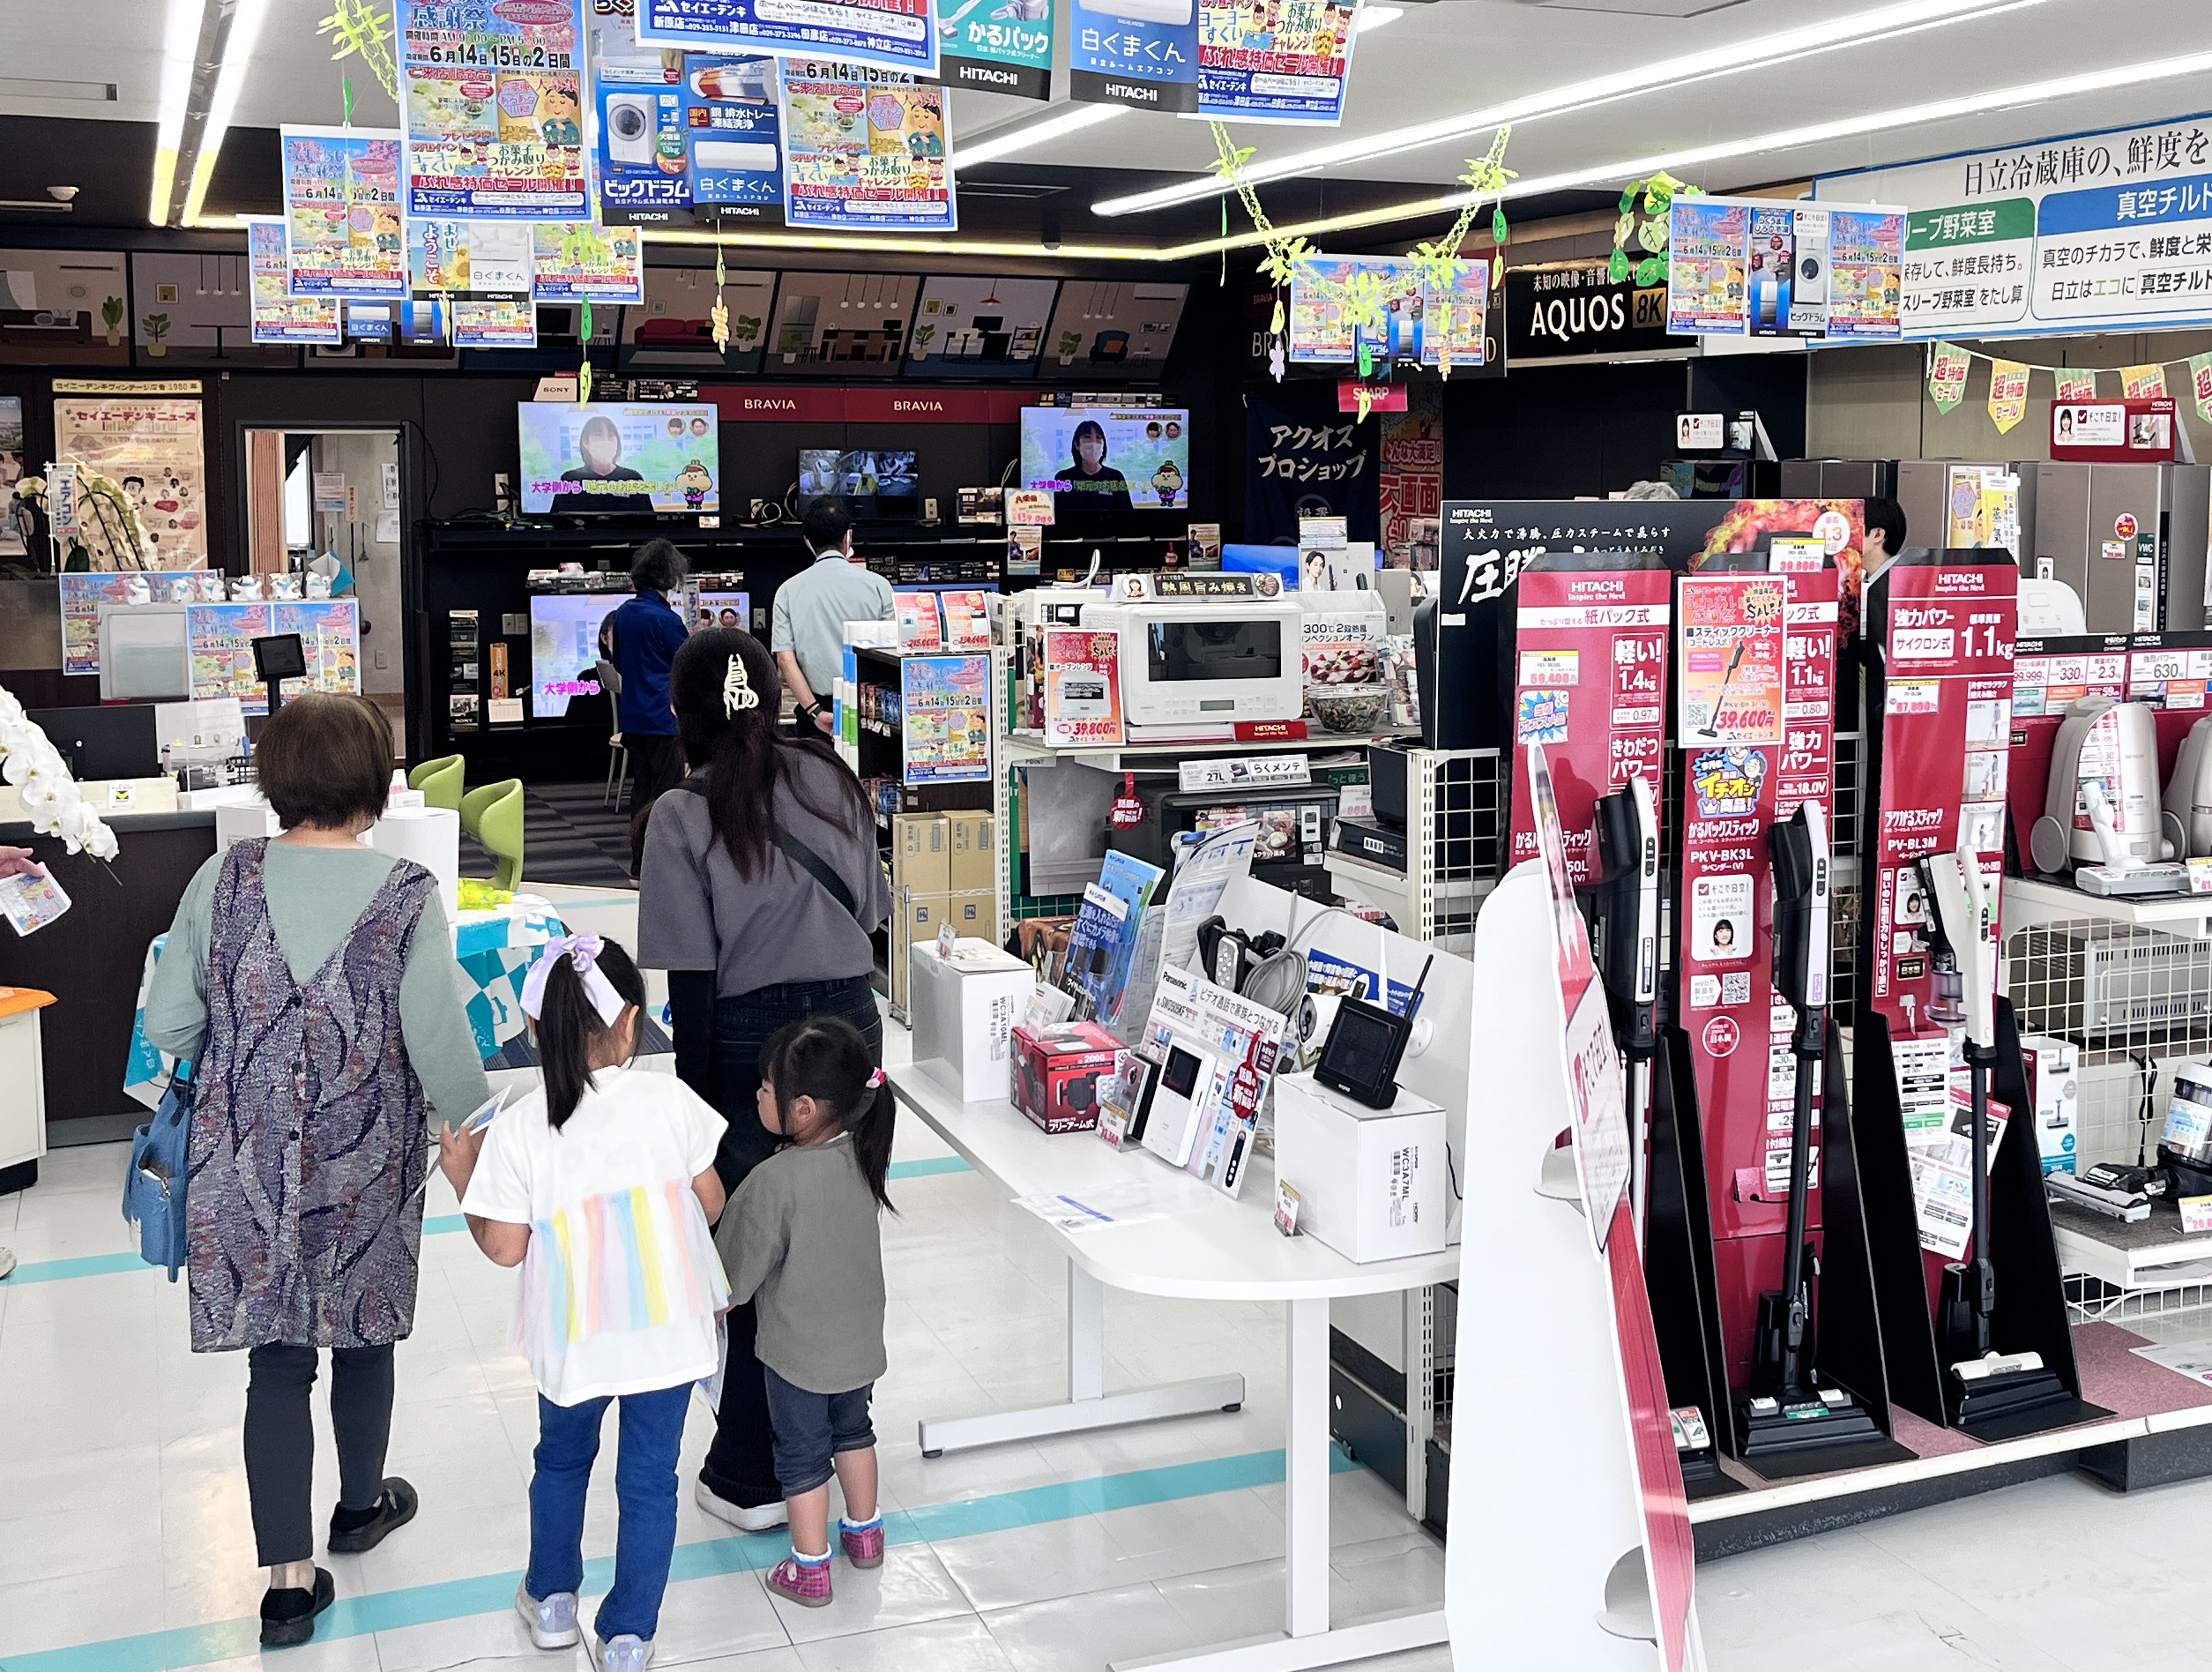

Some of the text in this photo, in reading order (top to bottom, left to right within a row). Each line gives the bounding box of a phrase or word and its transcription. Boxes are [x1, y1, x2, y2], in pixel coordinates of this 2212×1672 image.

[413, 6, 485, 31] 感謝祭
[681, 3, 746, 18] セイエーデンキ
[1288, 3, 1316, 18] お菓子
[1277, 18, 1322, 34] つかみ取り
[967, 21, 1049, 52] かるパック
[1206, 26, 1243, 43] すくい
[1081, 28, 1186, 63] 白くまくん
[959, 67, 1018, 86] HITACHI
[1106, 84, 1158, 101] HITACHI
[499, 146, 533, 155] お菓子
[488, 154, 545, 166] つかみ取り
[869, 156, 899, 166] お菓子
[1965, 129, 2209, 197] 日立冷蔵庫の、鮮度を
[859, 166, 911, 176] つかみ取り
[605, 179, 690, 198] ビッグドラム
[700, 177, 776, 193] 白くまくん
[720, 207, 759, 216] HITACHI
[423, 224, 439, 284] ようこそ
[473, 271, 525, 280] 白くまくん
[2052, 276, 2135, 302] 日立はエコに
[1531, 293, 1665, 341] AQUOS 8K
[1791, 312, 1825, 323] ビッグドラム
[1935, 385, 1958, 401] セール
[744, 399, 796, 410] BRAVIA
[894, 400, 943, 412] BRAVIA
[1995, 403, 2021, 419] セール
[76, 411, 196, 422] セイエーデンキニュース
[1270, 425, 1354, 451] アクオス
[1258, 450, 1367, 482] プロショップ
[532, 481, 582, 494] 大学側から
[1030, 480, 1073, 491] 大学側から
[60, 480, 74, 526] エアコン
[2138, 543, 2153, 554] VWC
[1571, 581, 1623, 592] HITACHI
[1939, 574, 1983, 584] HITACHI
[1609, 592, 1626, 601] Next
[1585, 608, 1650, 624] 紙パック式
[1895, 608, 1955, 627] 強力パワー
[1896, 637, 1951, 650] サイクロン式
[1961, 625, 2014, 660] 1.1kg
[1619, 670, 1657, 690] 1.4kg
[1791, 666, 1823, 685] 1.1kg
[545, 680, 600, 696] 大学側から
[1717, 711, 1775, 728] 39,600円
[1073, 722, 1115, 735] 39,800円
[1612, 737, 1658, 758] きわだつ
[1789, 730, 1821, 750] 強力
[1254, 762, 1300, 774] らくメンテ
[1612, 760, 1657, 778] パワー
[1781, 752, 1827, 771] パワー
[1207, 773, 1225, 781] 27L
[1329, 773, 1365, 783] っと使う
[1698, 773, 1755, 798] イチオシ
[1798, 781, 1827, 795] 18.0V
[1884, 809, 1943, 827] ラクかるスティック
[1688, 818, 1759, 839] かるパックスティック
[1888, 837, 1938, 850] PV-BL3M
[1691, 848, 1754, 862] PKV-BK3L
[1163, 972, 1188, 990] Panasonic
[1200, 988, 1278, 1034] ビデオ通話で家族とつながる
[1049, 1120, 1095, 1131] フリーアーム式
[1402, 1147, 1411, 1201] WC3A7ML
